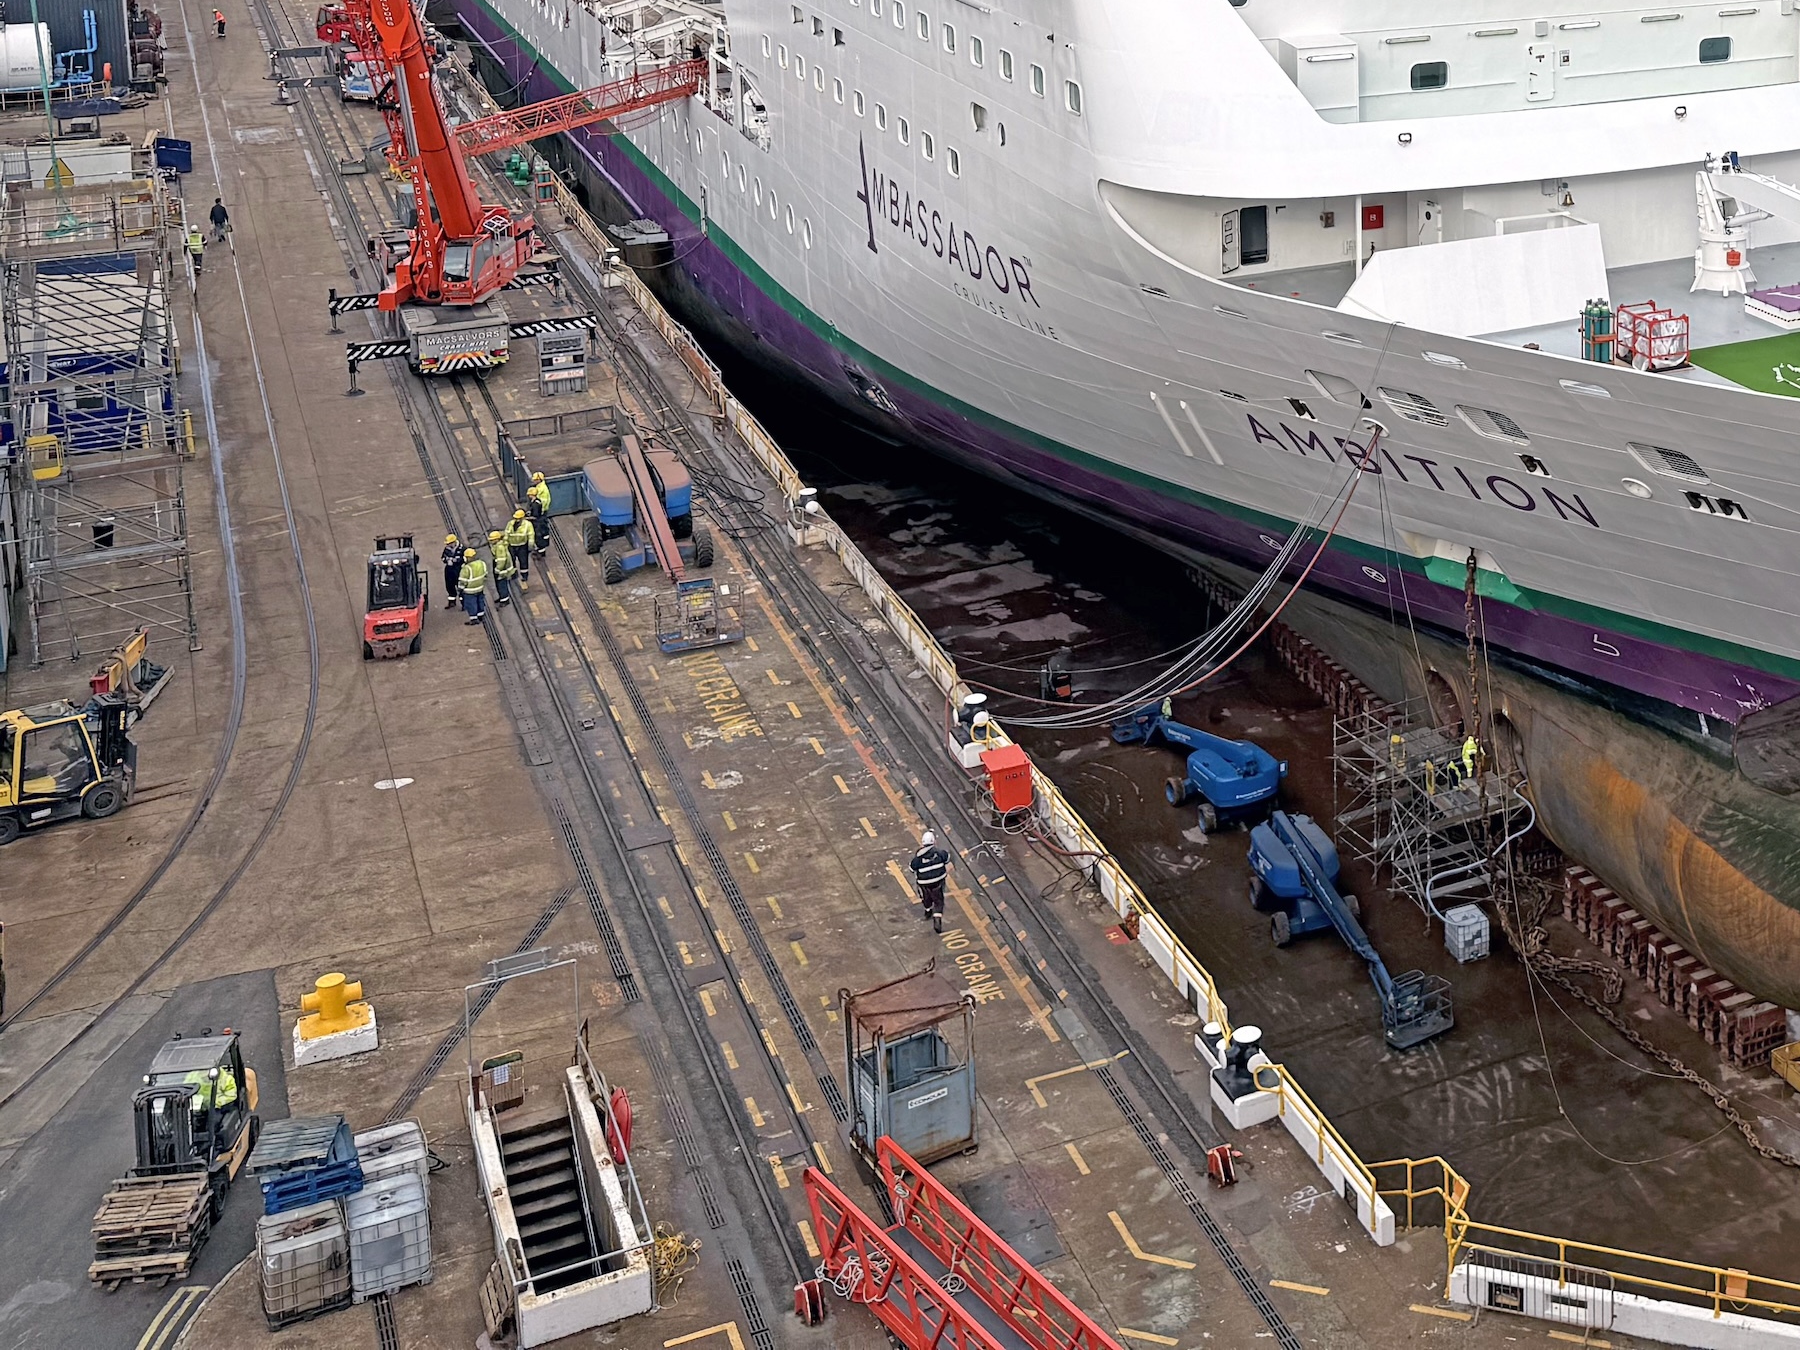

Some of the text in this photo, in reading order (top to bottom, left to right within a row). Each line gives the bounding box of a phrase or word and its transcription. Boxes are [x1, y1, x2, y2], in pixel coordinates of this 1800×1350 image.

[410, 165, 435, 269] MACSALVORS
[426, 330, 500, 347] MACSALVORS
[953, 282, 1060, 340] CRUISE LINE
[1246, 413, 1601, 528] AMBITION
[695, 676, 765, 743] CRANE
[939, 929, 1006, 1005] NO CRANE
